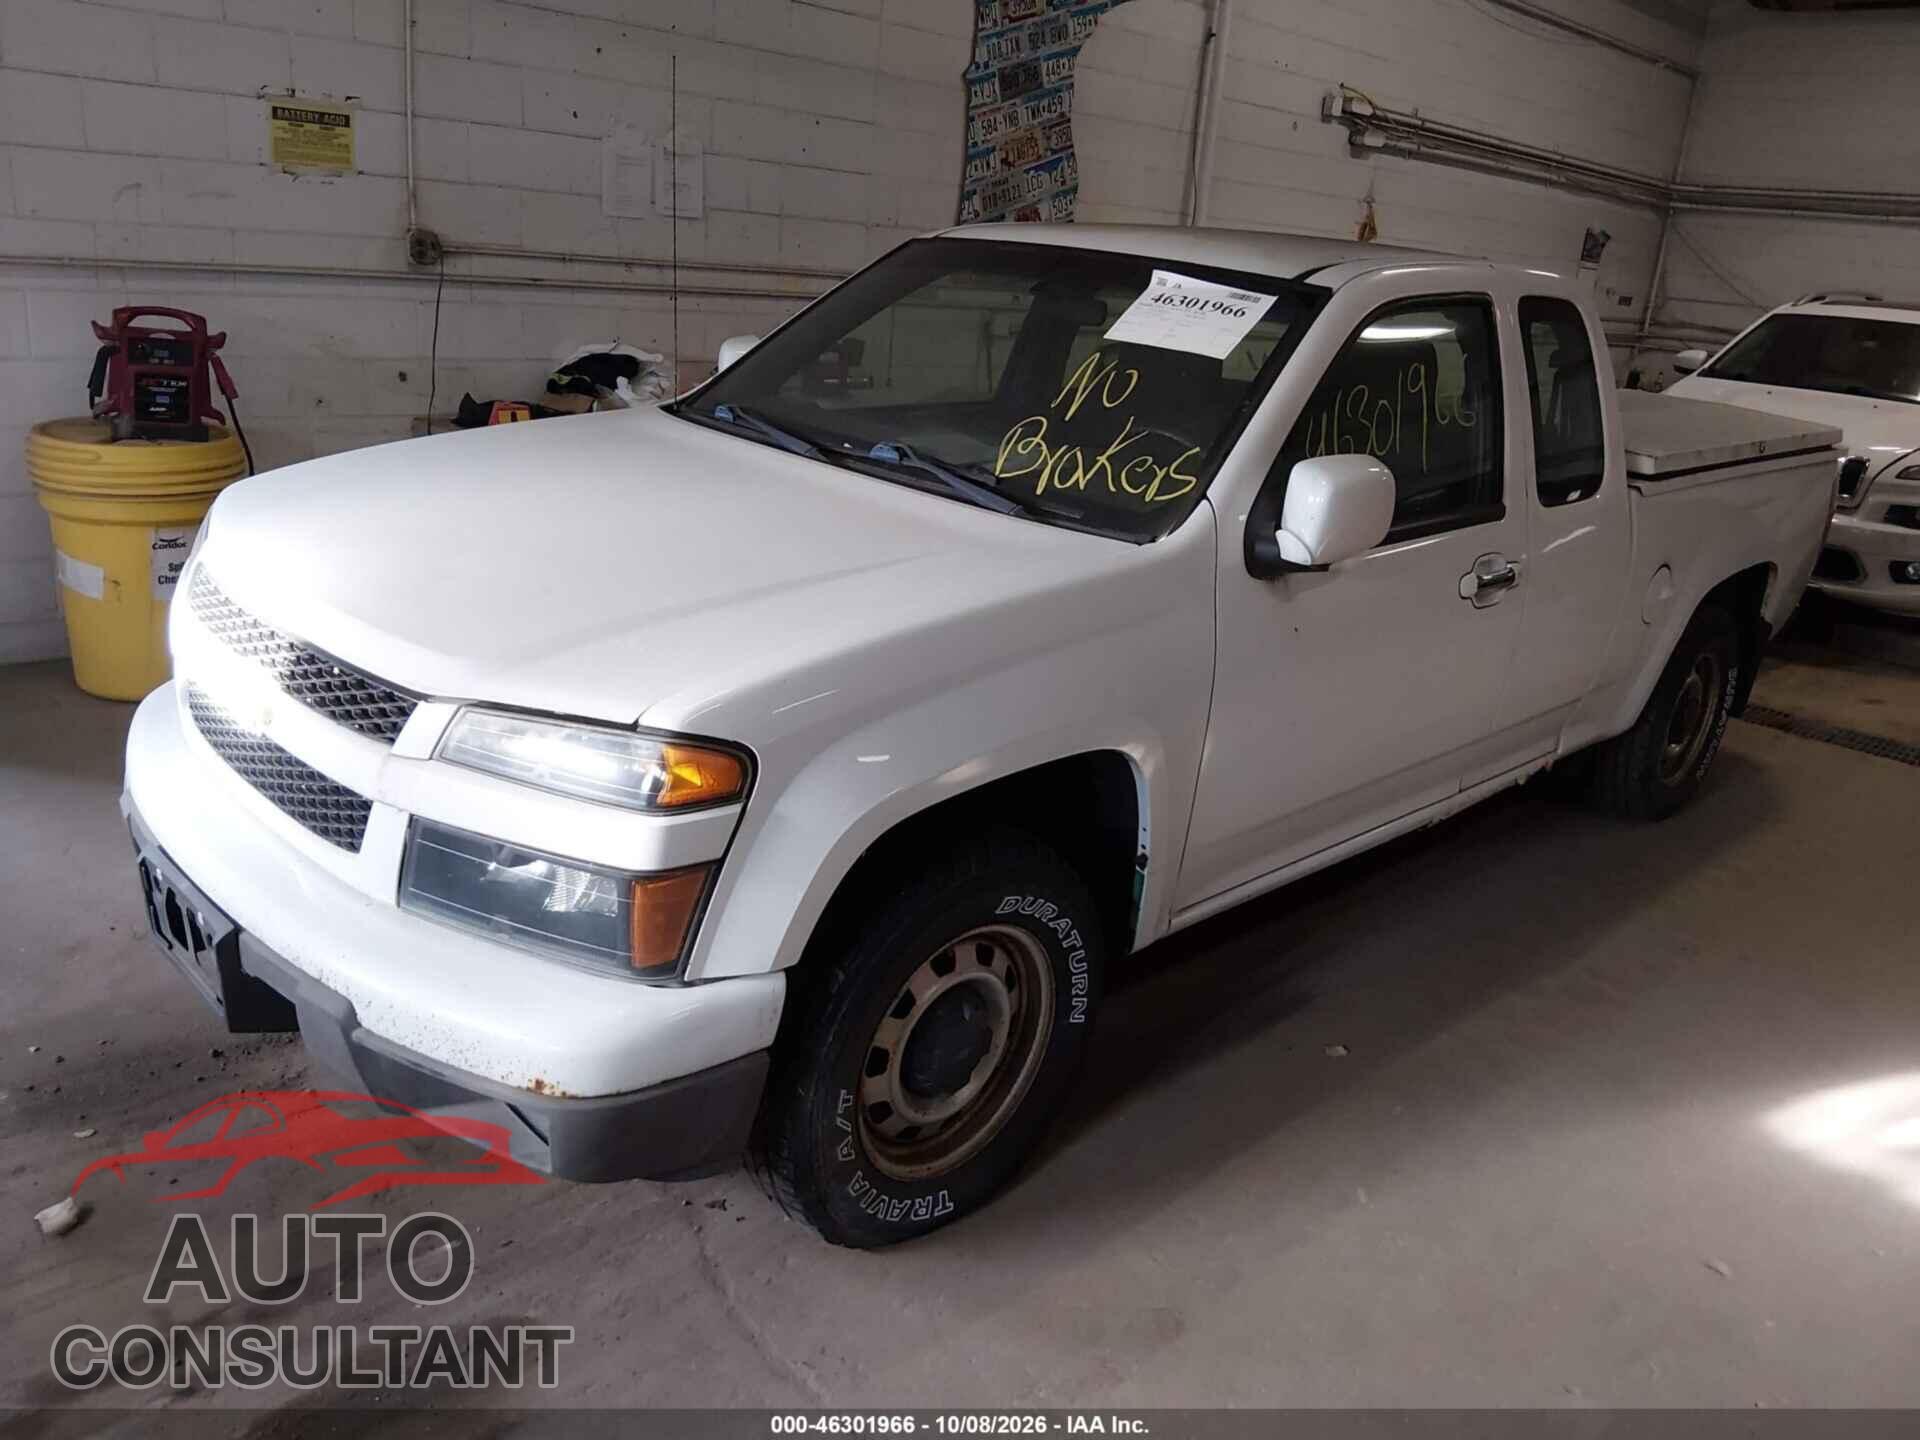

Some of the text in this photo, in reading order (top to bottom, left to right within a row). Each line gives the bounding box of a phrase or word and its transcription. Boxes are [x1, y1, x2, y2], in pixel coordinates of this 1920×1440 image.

[1151, 292, 1247, 318] 46301966
[994, 895, 1089, 1023] DURATURN
[836, 1089, 954, 1222] TRAVIA A/T
